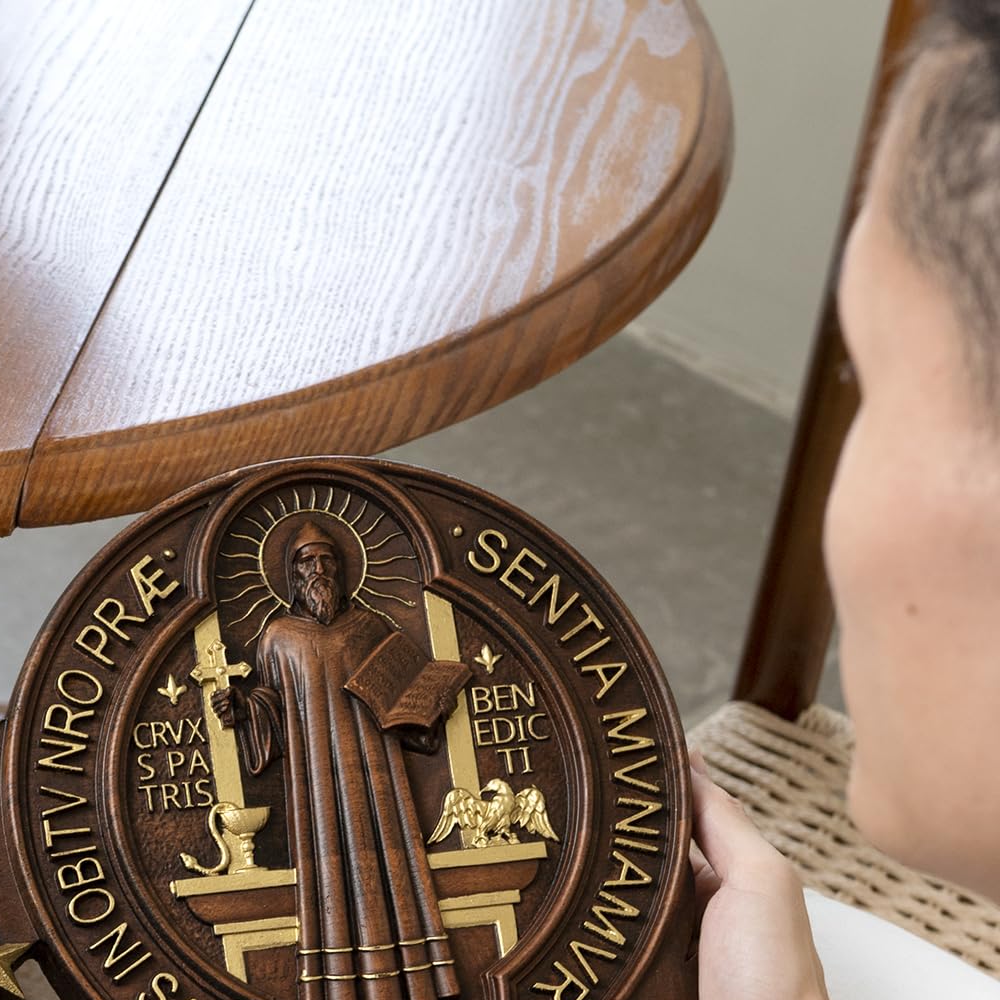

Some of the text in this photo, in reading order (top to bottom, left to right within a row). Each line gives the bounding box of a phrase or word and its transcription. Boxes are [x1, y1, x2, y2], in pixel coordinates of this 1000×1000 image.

[467, 528, 628, 700] SENTIA
[471, 680, 536, 715] BEN
[38, 669, 104, 773] NRO
[133, 717, 206, 749] CRVX
[473, 712, 551, 747] EDIC
[137, 748, 210, 781] S PA
[497, 746, 534, 775] TI
[138, 779, 215, 812] TRIS
[39, 785, 115, 924] OBITV
[88, 922, 152, 981] IN
